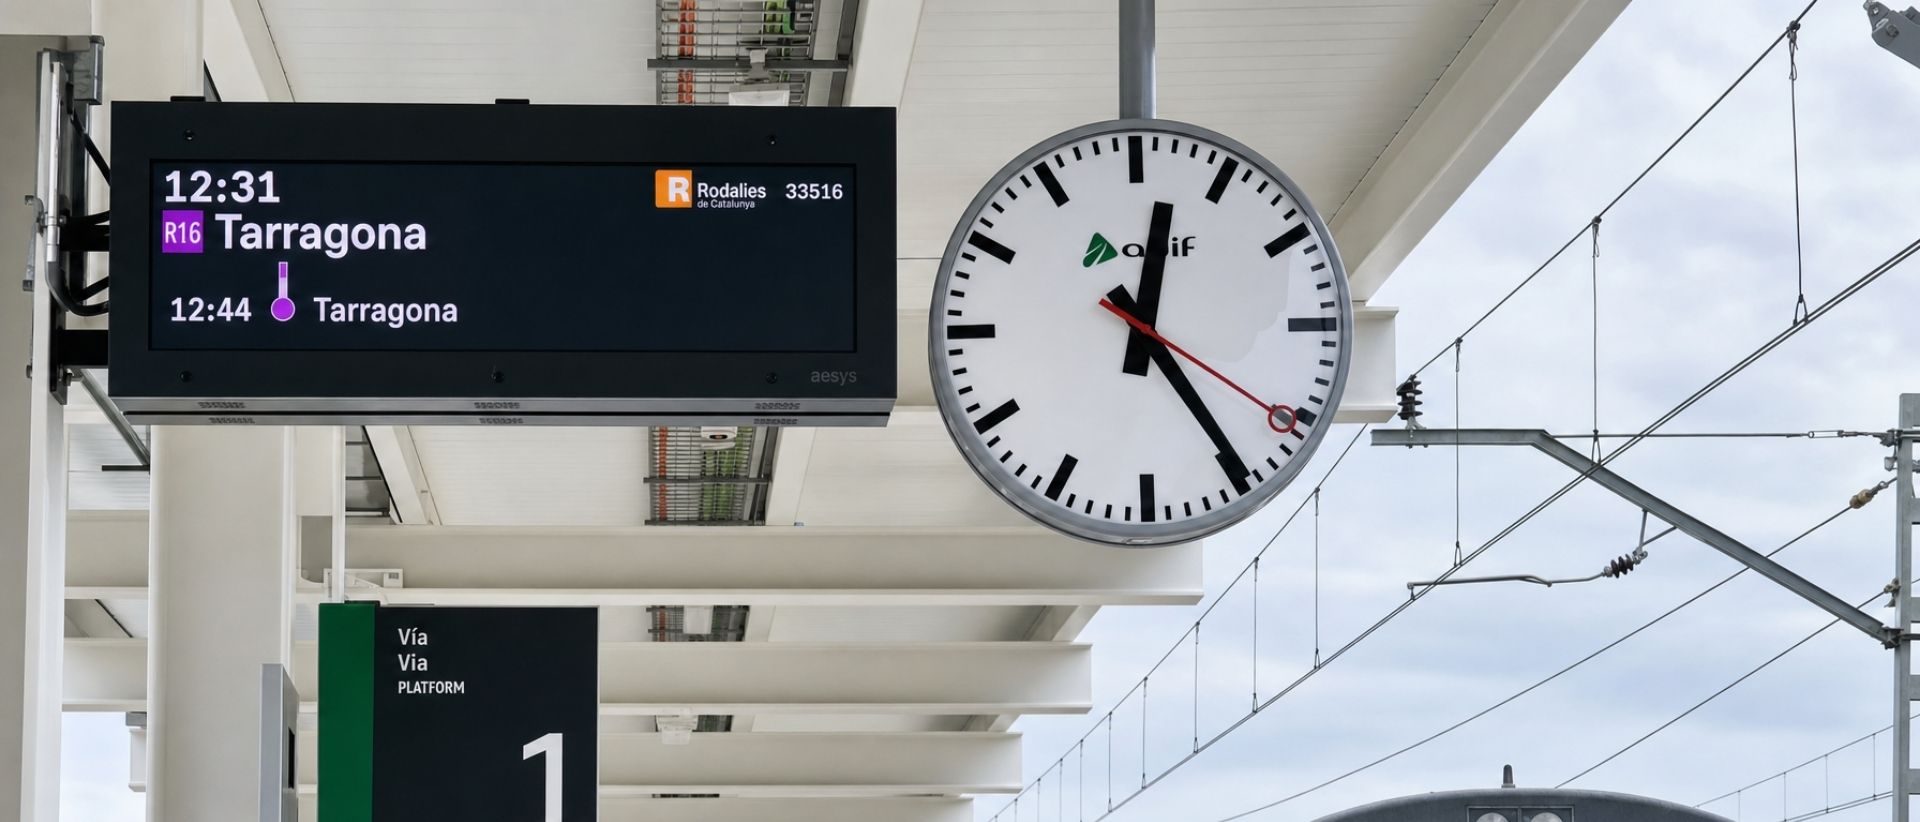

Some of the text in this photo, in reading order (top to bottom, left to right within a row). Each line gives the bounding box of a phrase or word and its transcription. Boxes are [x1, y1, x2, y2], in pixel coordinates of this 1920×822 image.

[164, 170, 280, 203] 12:31
[668, 176, 690, 202] R
[697, 182, 767, 198] Rodalies
[785, 183, 843, 199] 33516
[697, 199, 755, 210] de Catalunya
[164, 213, 427, 259] R16 Tarragona
[1121, 236, 1196, 258] aif
[170, 297, 458, 329] 12:44 Tarragona
[810, 370, 857, 386] aesys
[397, 627, 428, 646] Vía
[397, 653, 428, 672] Via
[397, 681, 465, 694] PLATFORM
[522, 732, 564, 822] 1
